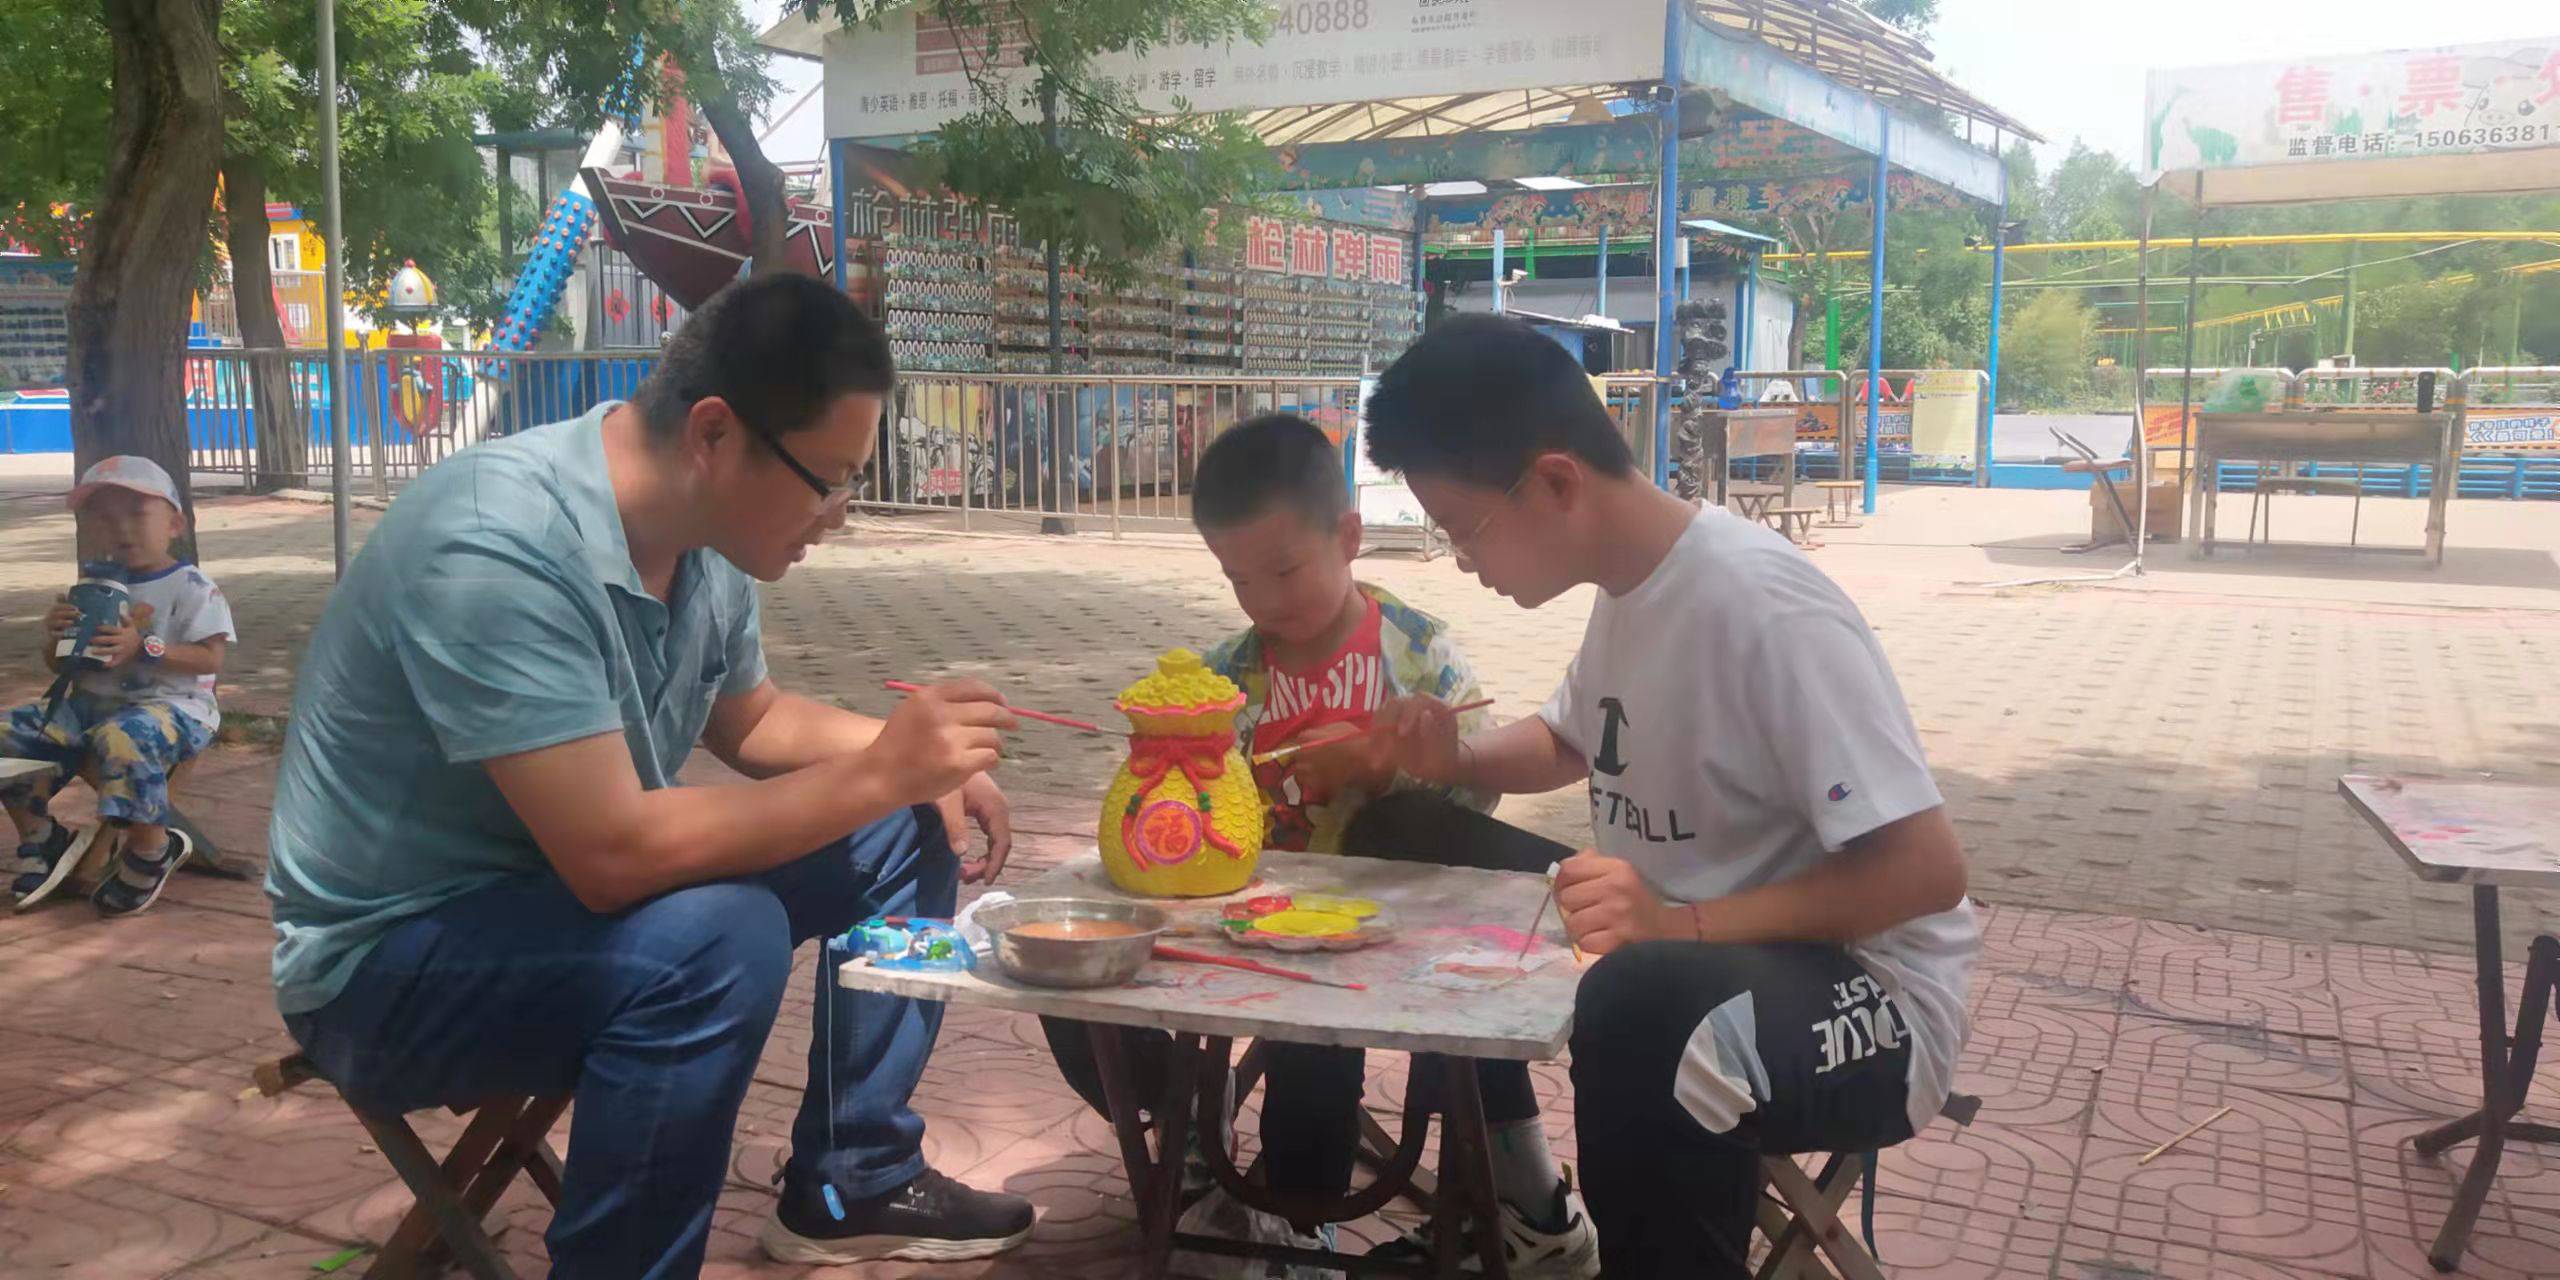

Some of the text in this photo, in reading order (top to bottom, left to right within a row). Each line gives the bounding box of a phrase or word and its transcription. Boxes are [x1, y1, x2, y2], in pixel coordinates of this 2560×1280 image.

[2414, 123, 2560, 148] 150636381
[1247, 214, 1402, 285] 枪林弹雨
